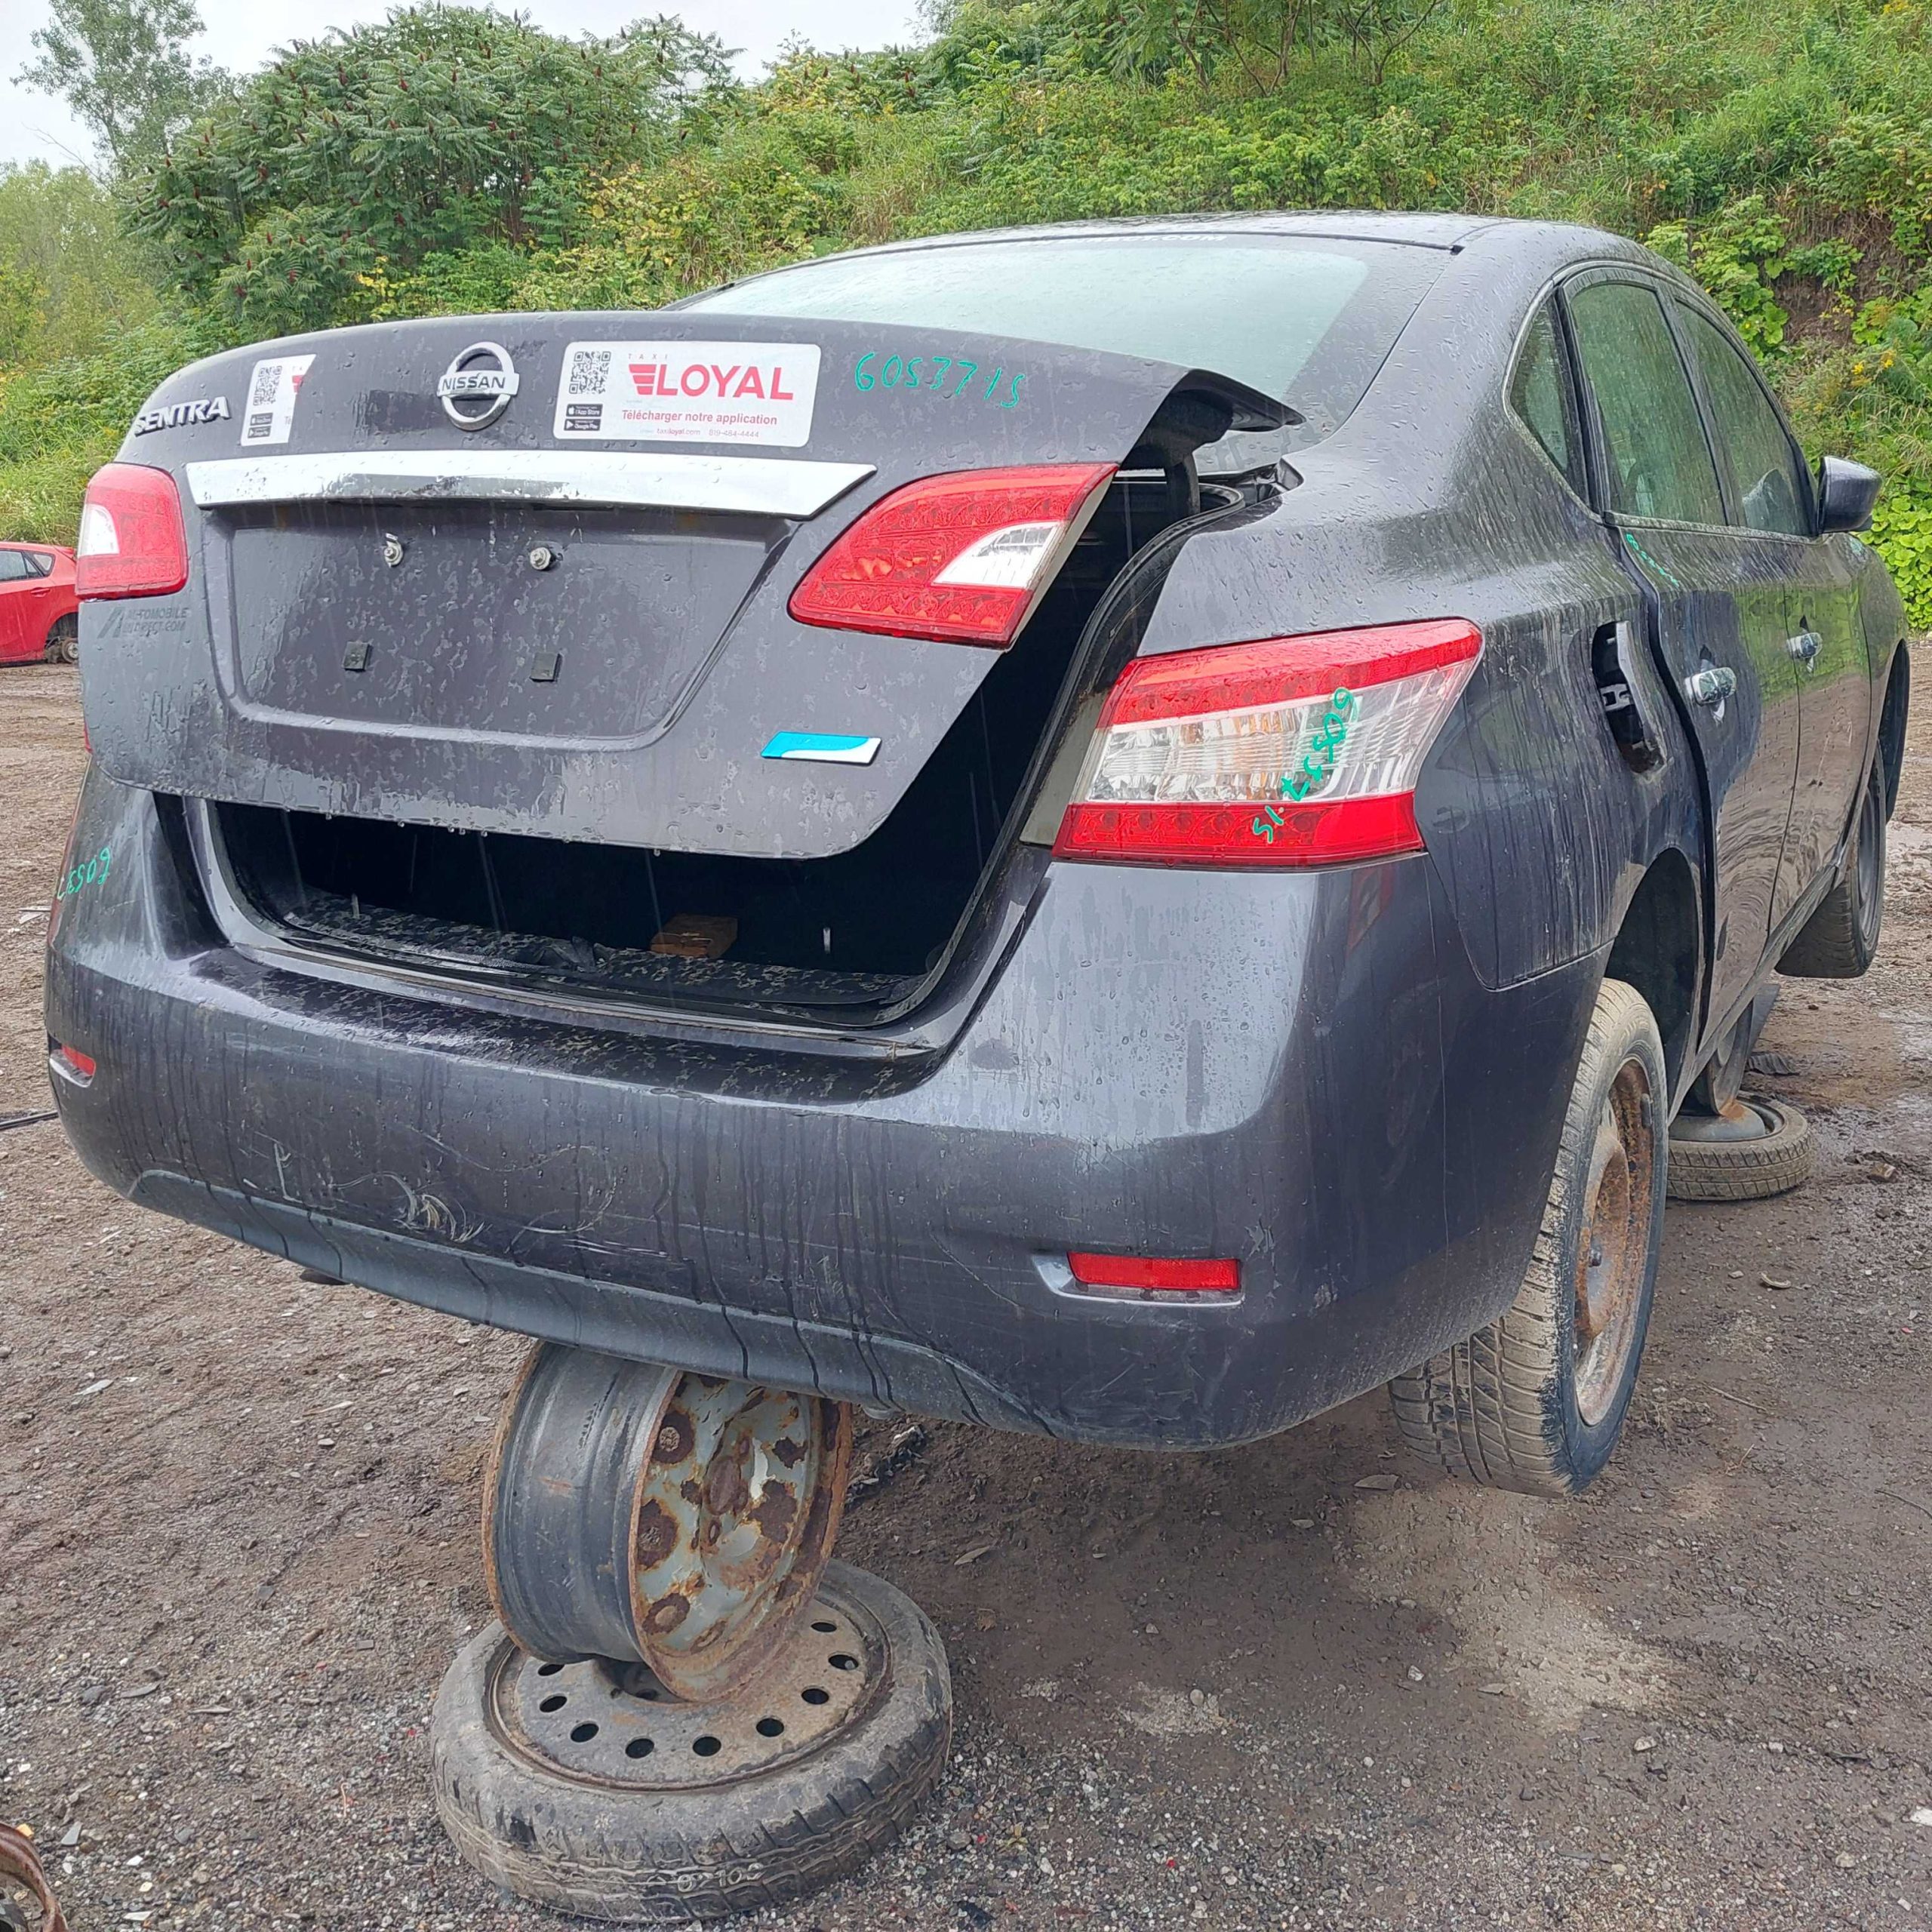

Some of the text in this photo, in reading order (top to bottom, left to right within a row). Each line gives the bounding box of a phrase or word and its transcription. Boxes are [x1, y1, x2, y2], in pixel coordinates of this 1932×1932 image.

[442, 377, 506, 390] NISSAN
[656, 364, 794, 401] LOYAL
[134, 395, 232, 436] SENTRA
[622, 410, 777, 425] Télécharger notre application
[657, 428, 700, 436] taxiloyal.com
